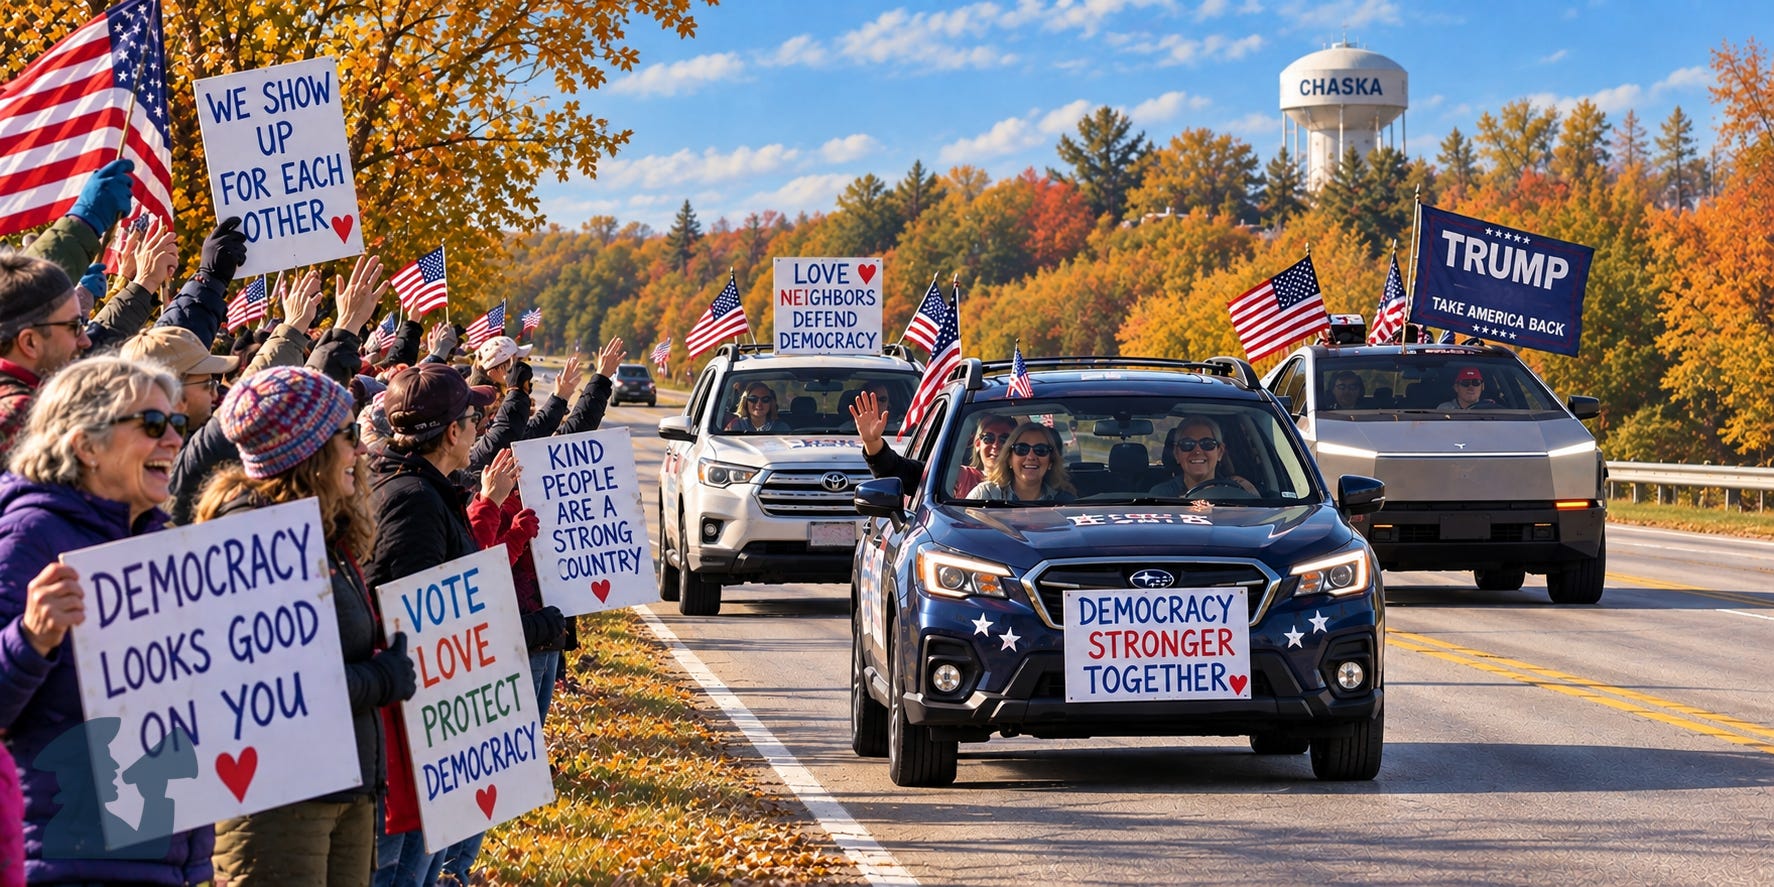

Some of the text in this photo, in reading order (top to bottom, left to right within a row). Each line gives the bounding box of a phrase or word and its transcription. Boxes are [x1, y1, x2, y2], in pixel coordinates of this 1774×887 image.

[206, 72, 330, 123] WE SHOW
[1300, 78, 1383, 96] CHASKA
[256, 121, 293, 156] UP
[220, 154, 344, 205] FOR EACH
[244, 199, 329, 243] OTHER
[795, 263, 849, 284] LOVE
[1442, 230, 1570, 291] TRUMP
[780, 289, 876, 306] NEIGHBORS
[794, 311, 857, 327] DEFEND
[1432, 296, 1565, 337] TAKE AMERICA BACK
[780, 332, 877, 349] DEMOCRACY
[548, 440, 603, 470] KIND
[543, 466, 618, 499] PEOPLE
[558, 495, 617, 525] ARE A
[553, 521, 632, 553] STRONG
[91, 523, 310, 628] DEMOCRACY
[402, 567, 486, 633] VOTE
[1079, 594, 1234, 626] DEMOCRACY
[100, 600, 318, 699] LOOKS GOOD
[416, 622, 496, 688] LOVE
[1088, 628, 1236, 659] STRONGER
[1084, 662, 1229, 694] TOGETHER
[140, 672, 308, 758] ON YOU
[422, 673, 521, 747] PROTECT
[423, 721, 536, 801] DEMOCRACY
